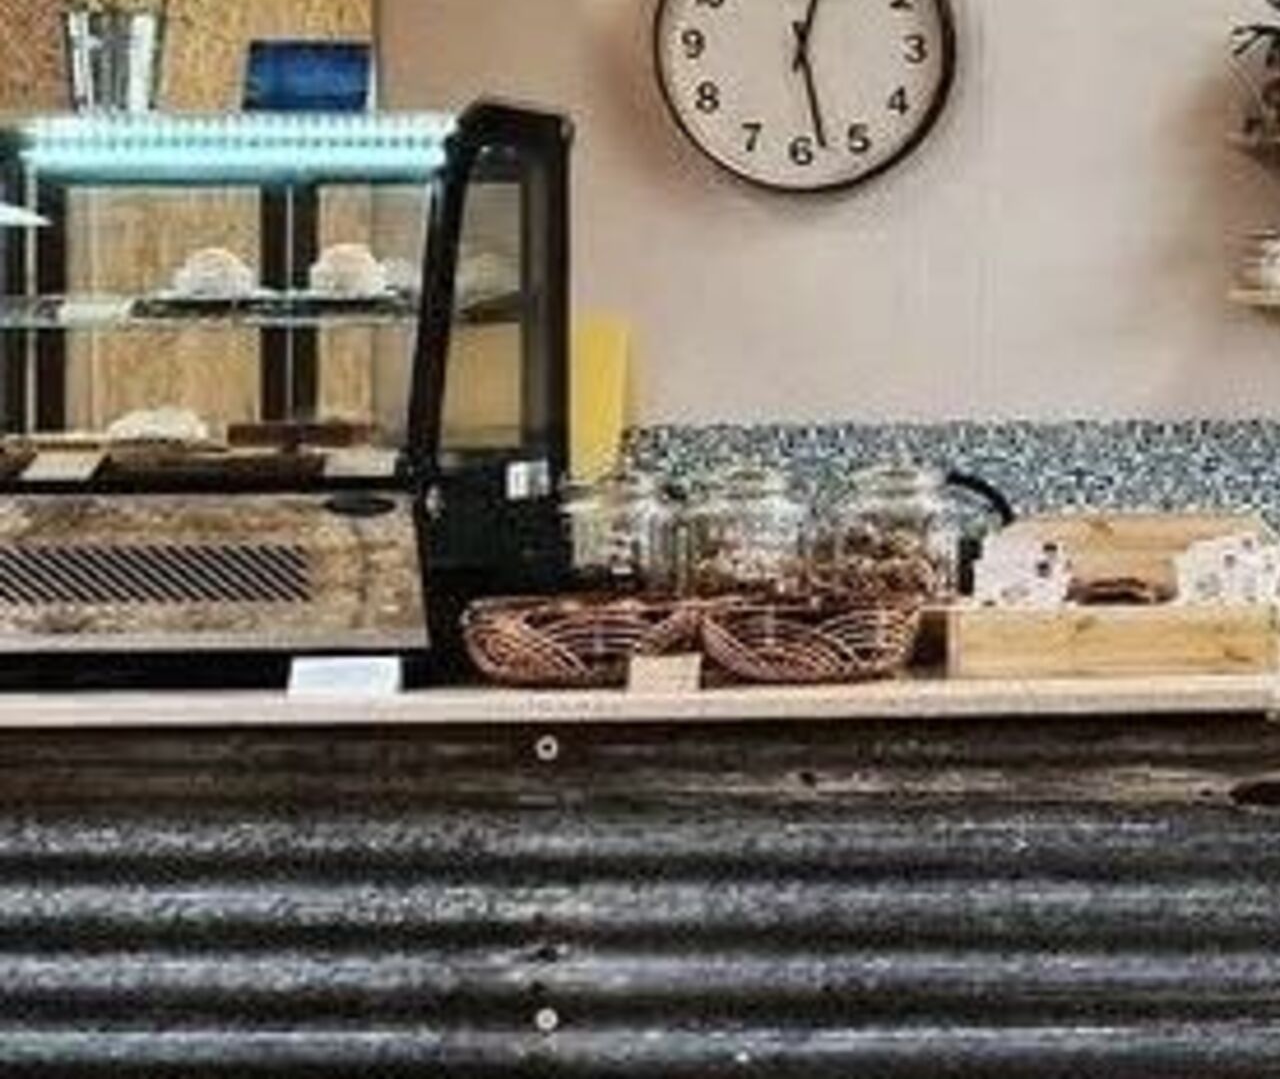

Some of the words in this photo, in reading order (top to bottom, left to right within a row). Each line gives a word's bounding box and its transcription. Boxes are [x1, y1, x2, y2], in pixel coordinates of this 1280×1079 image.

[681, 29, 705, 59] 9
[902, 34, 928, 64] 3
[695, 81, 720, 114] 8
[887, 87, 910, 115] 4
[742, 122, 762, 153] 7
[788, 137, 813, 166] 6
[847, 123, 871, 153] 5
